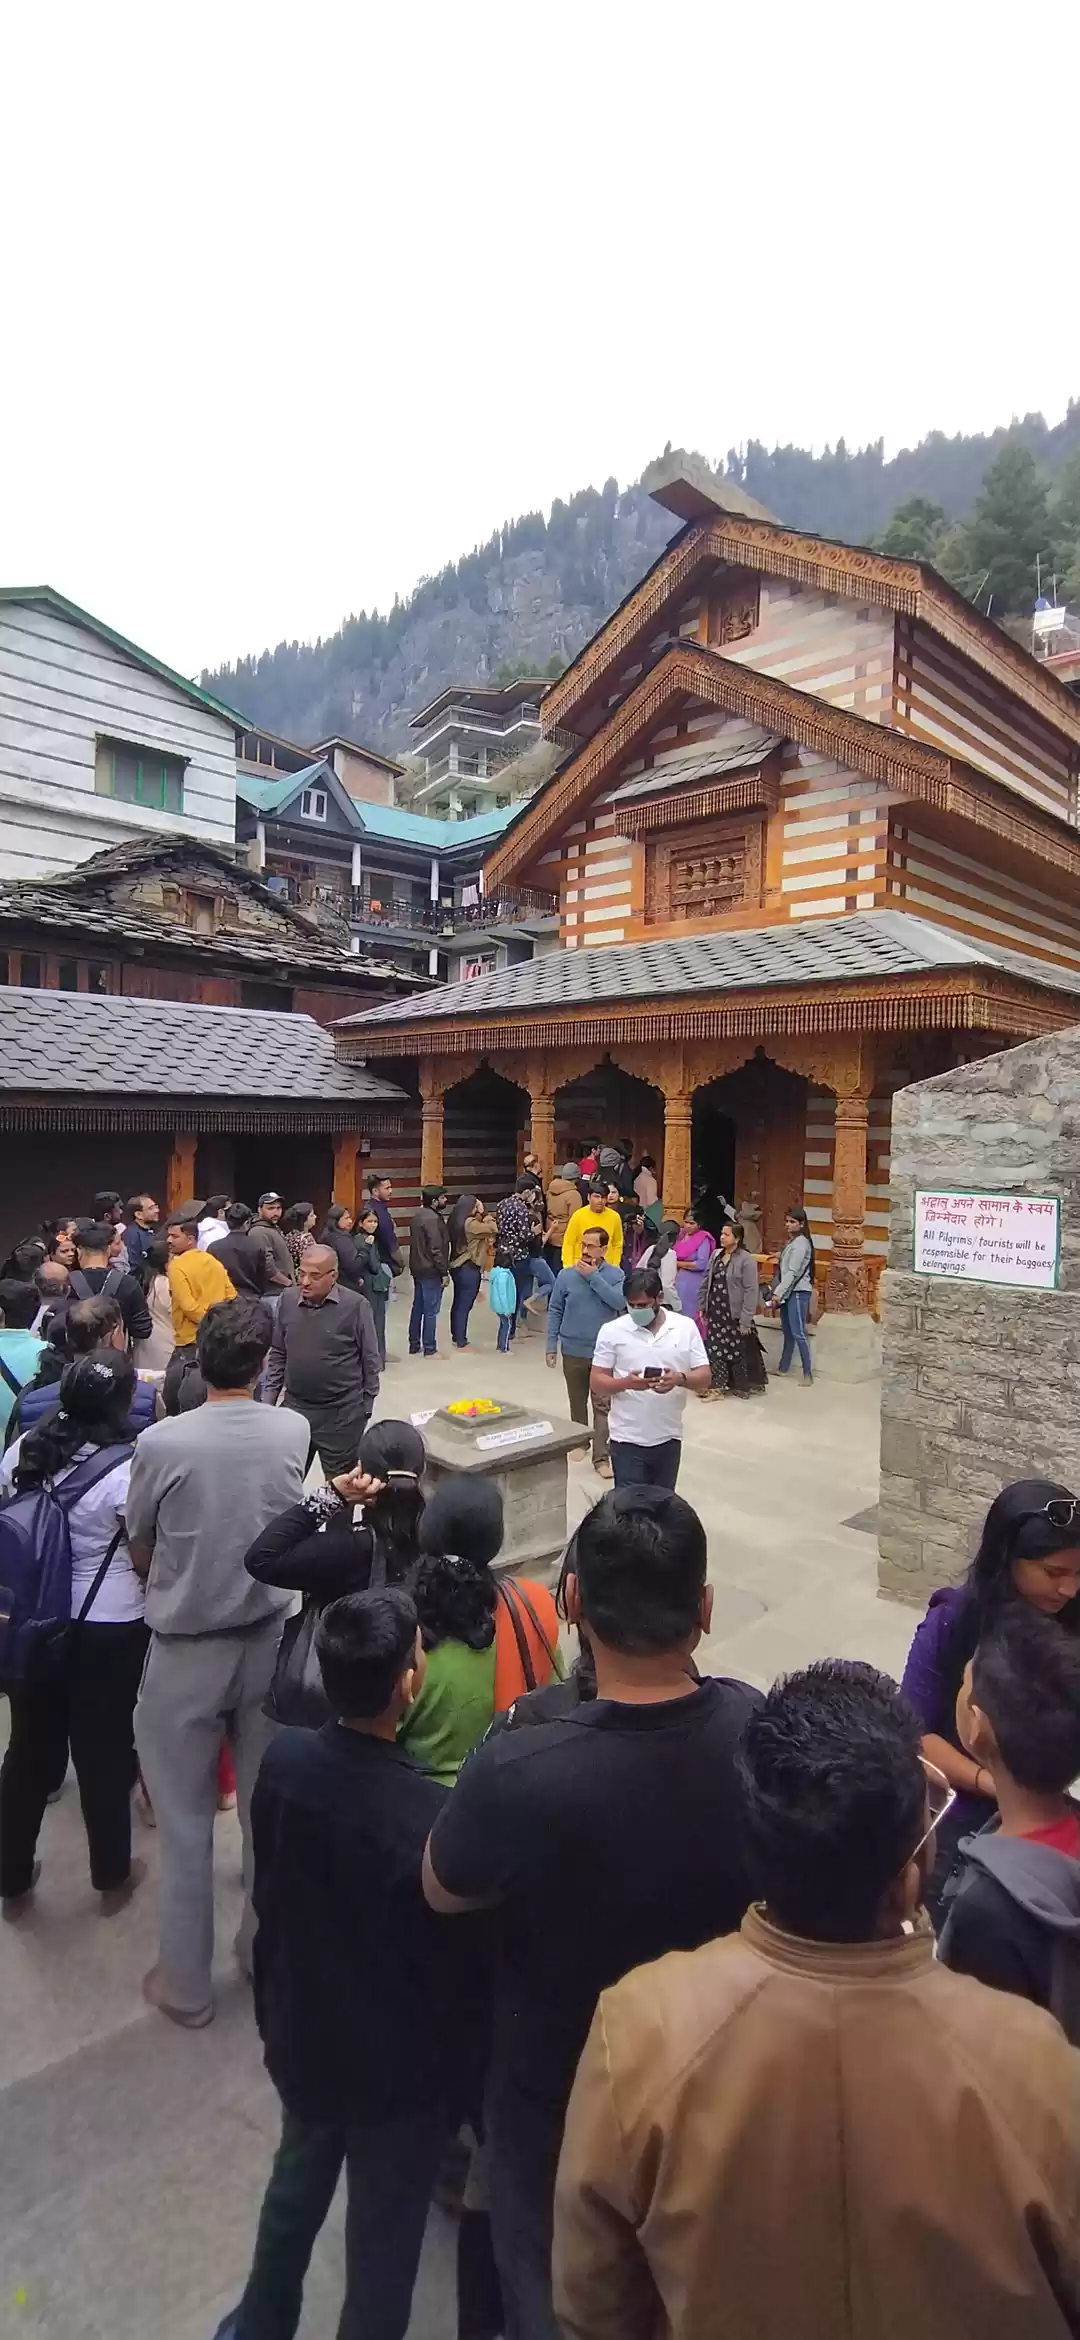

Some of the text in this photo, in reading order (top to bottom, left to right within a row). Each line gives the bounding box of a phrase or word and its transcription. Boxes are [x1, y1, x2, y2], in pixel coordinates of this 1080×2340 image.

[951, 1197, 975, 1209] अपने
[978, 1200, 1010, 1212] सामान
[1013, 1200, 1023, 1213] के
[923, 1230, 935, 1240] All
[1015, 1240, 1031, 1250] will
[1035, 1241, 1046, 1251] be
[922, 1248, 969, 1260] responsible
[972, 1250, 986, 1262] for
[991, 1253, 1013, 1264] their
[922, 1260, 966, 1274] belongings
